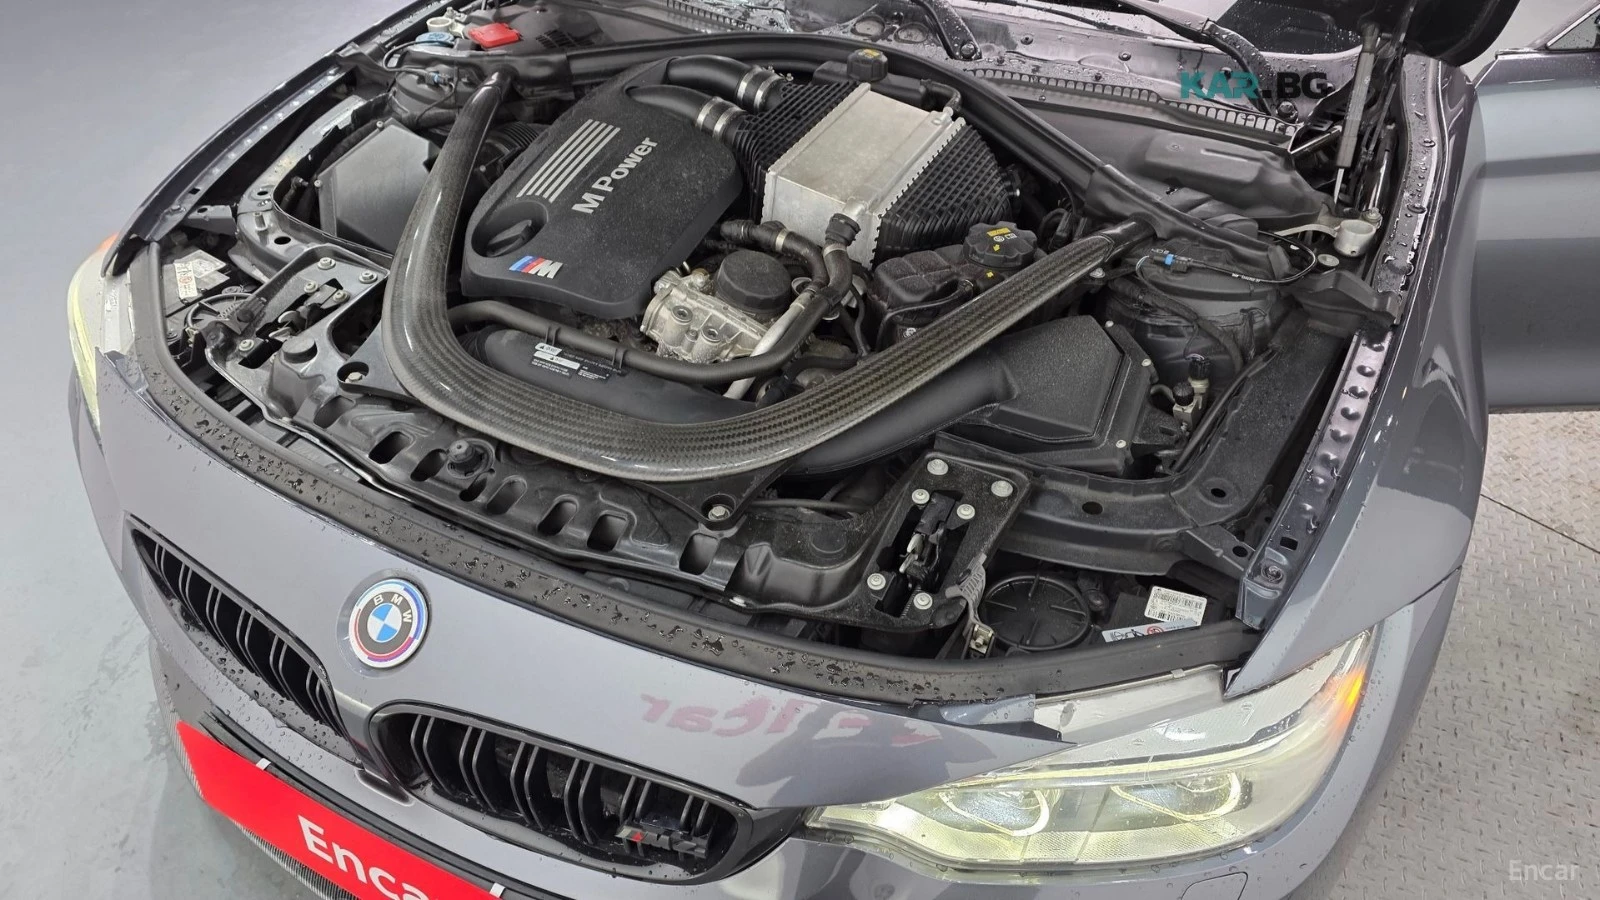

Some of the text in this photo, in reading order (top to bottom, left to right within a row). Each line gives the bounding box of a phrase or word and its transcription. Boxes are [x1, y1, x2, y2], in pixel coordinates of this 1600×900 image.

[572, 136, 659, 214] M Power
[374, 594, 412, 623] BMW
